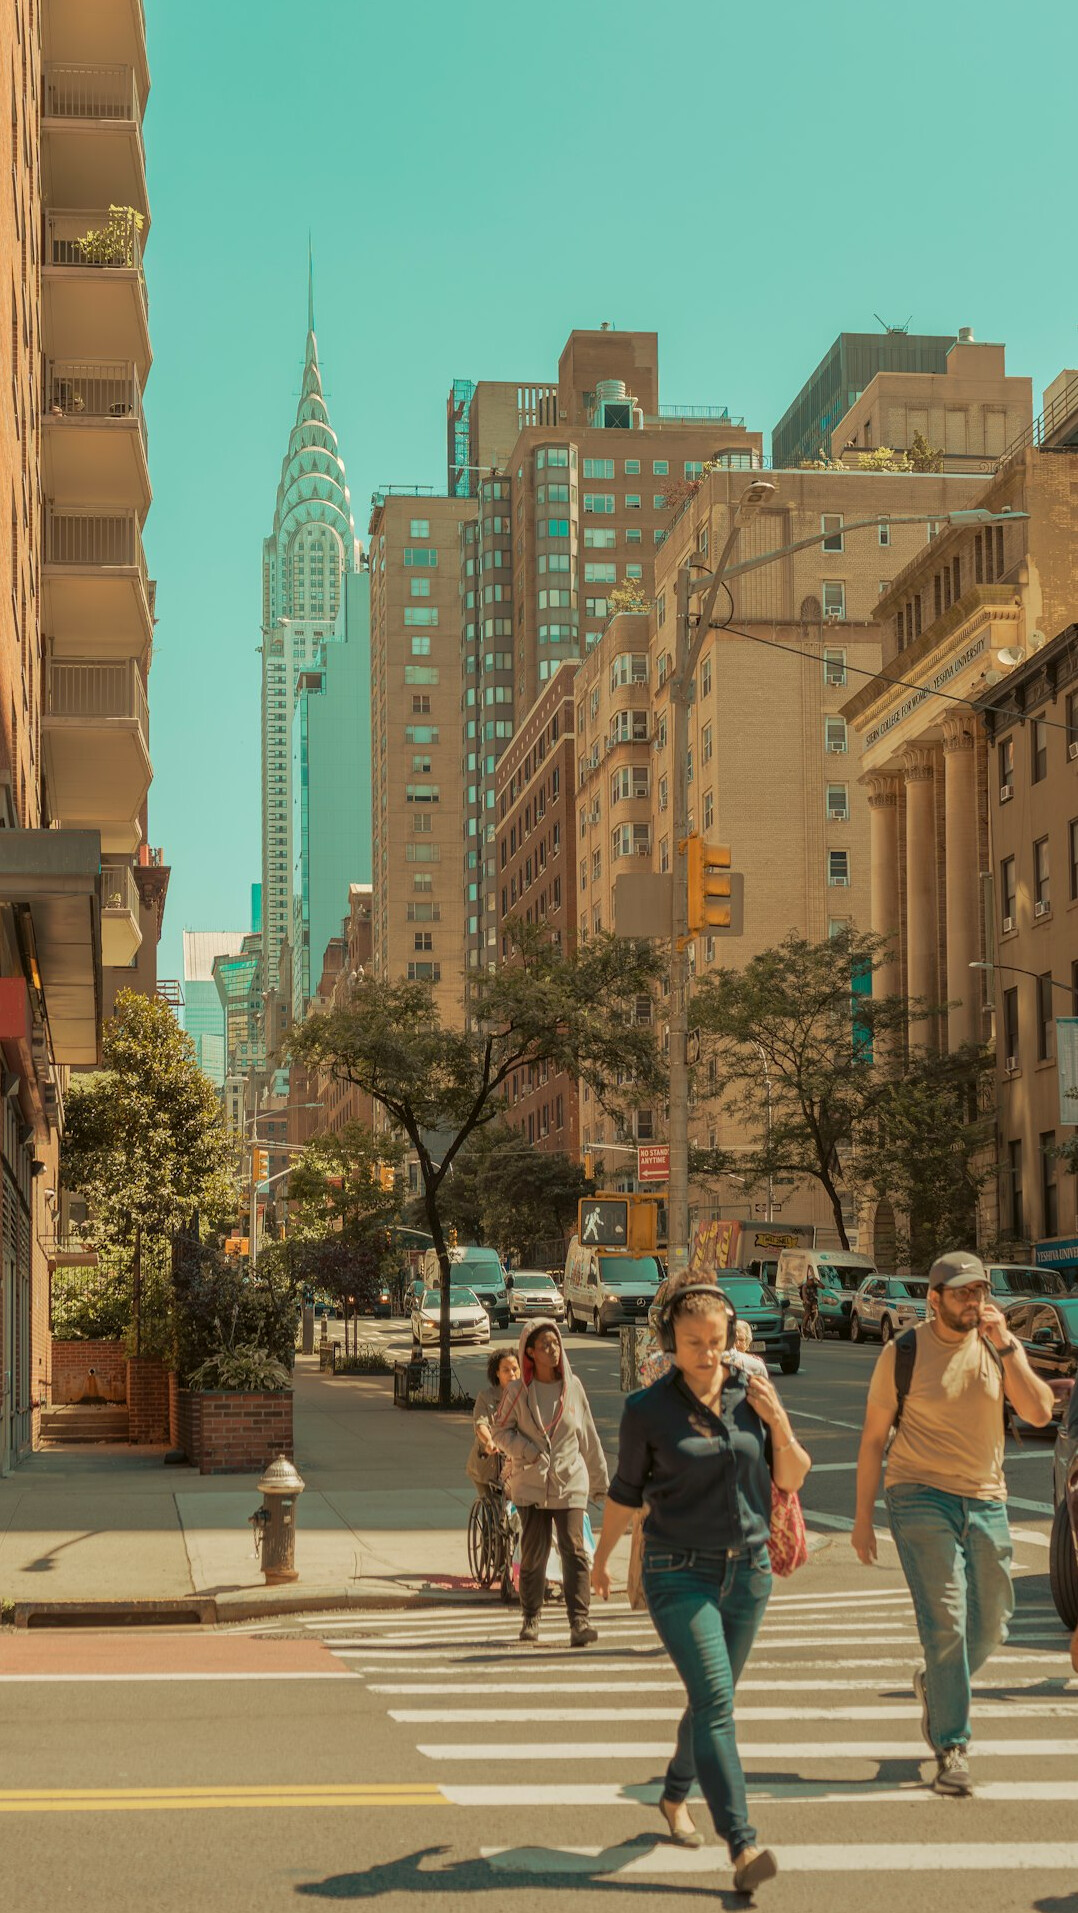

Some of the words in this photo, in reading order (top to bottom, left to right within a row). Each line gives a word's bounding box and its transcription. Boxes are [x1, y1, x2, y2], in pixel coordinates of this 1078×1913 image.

[866, 728, 880, 747] STERN
[880, 709, 900, 735] COLLEGE
[901, 700, 912, 718] FOR
[911, 684, 931, 708] WOMEN
[933, 665, 954, 689] YESHIVA
[954, 637, 985, 672] UNIVERSITY
[1037, 1250, 1059, 1262] YESHIVA
